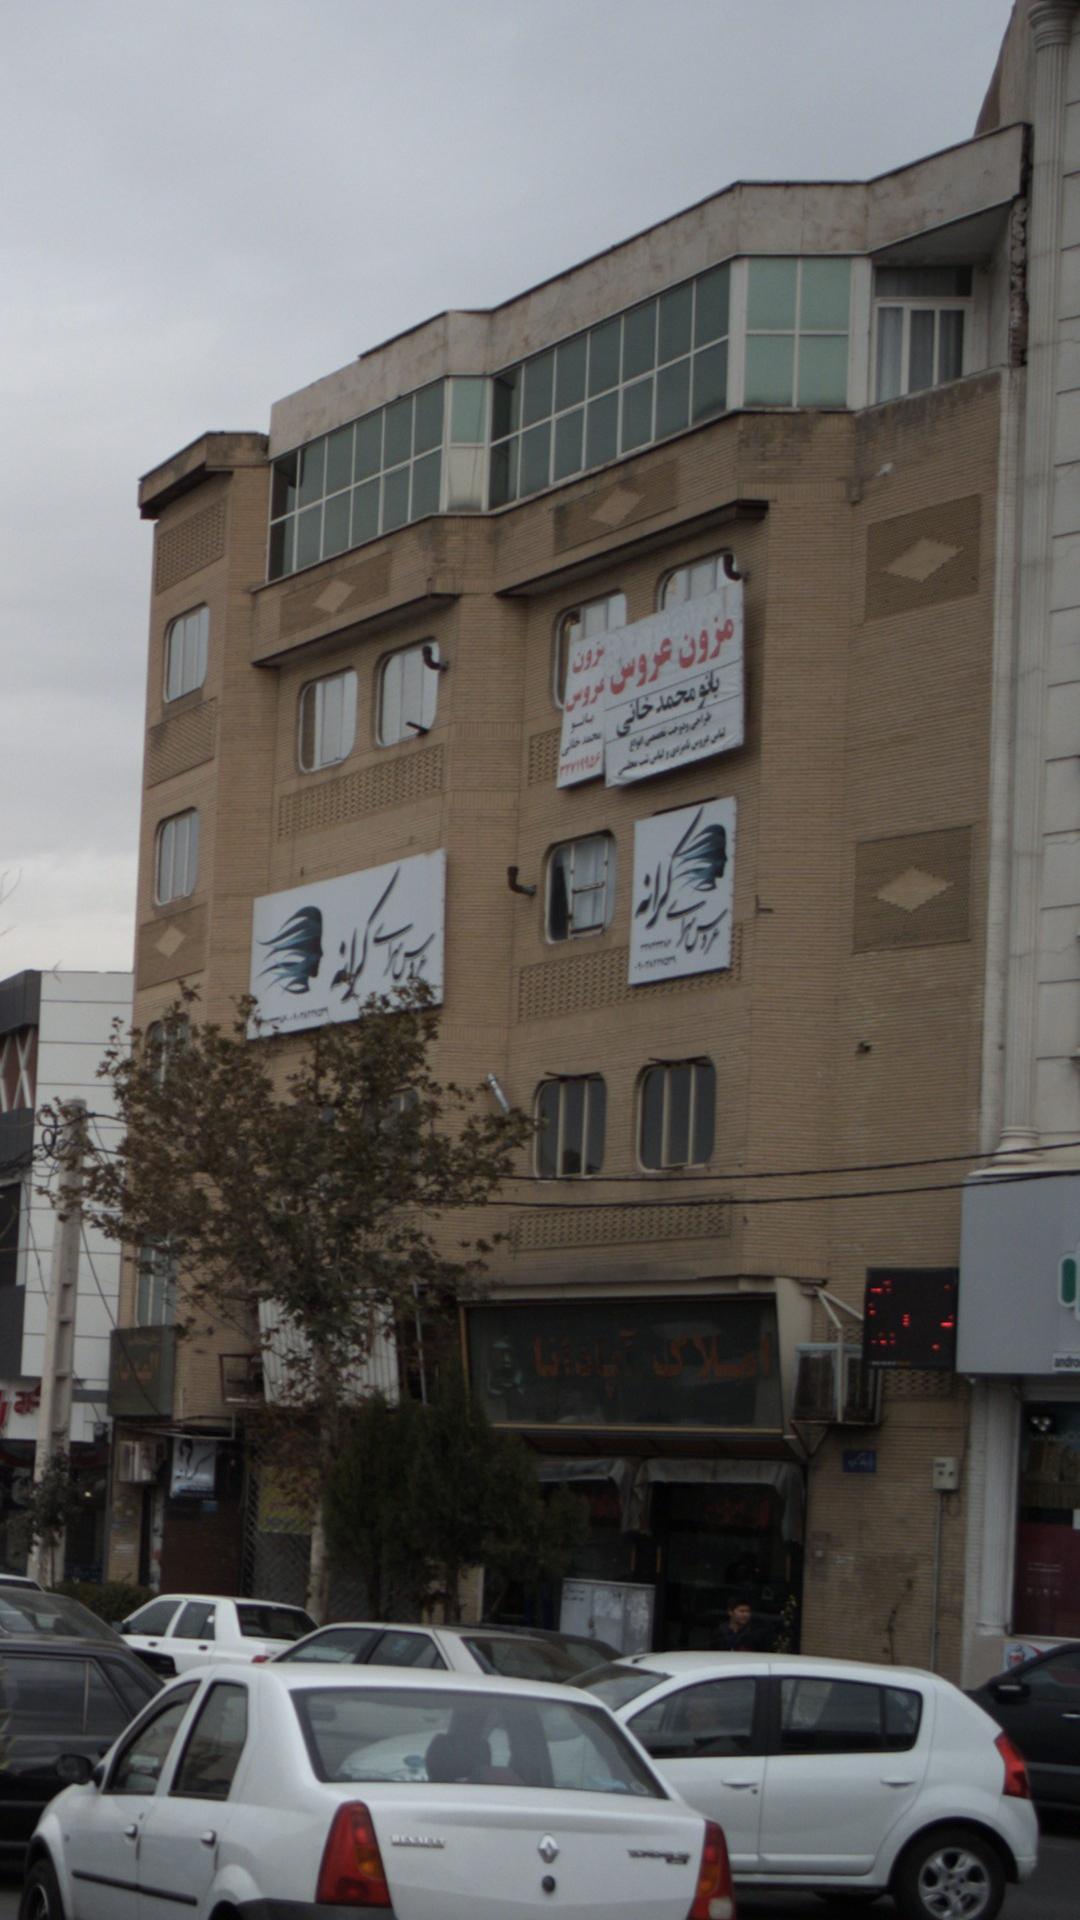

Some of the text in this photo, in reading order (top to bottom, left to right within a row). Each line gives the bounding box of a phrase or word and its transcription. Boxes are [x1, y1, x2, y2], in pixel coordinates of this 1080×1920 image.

[610, 617, 734, 694] مزون عروس
[698, 669, 720, 710] بانو
[652, 1331, 770, 1377] املاک
